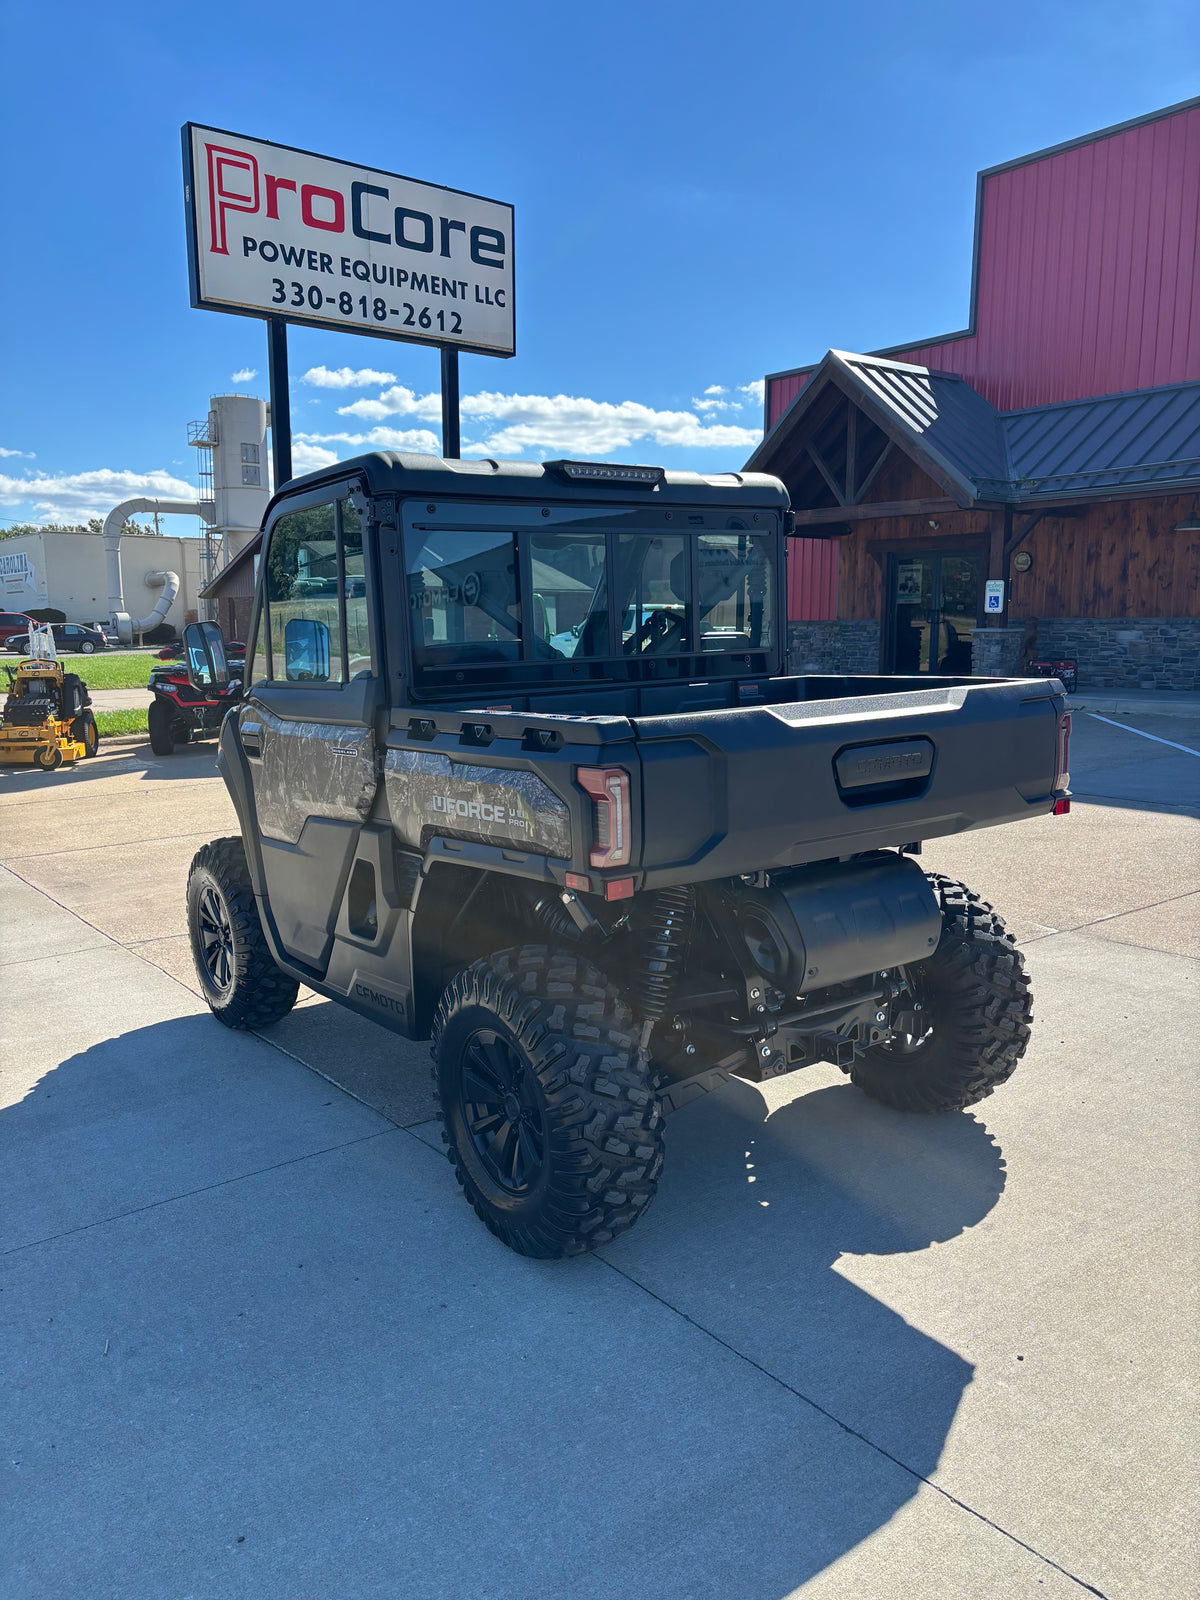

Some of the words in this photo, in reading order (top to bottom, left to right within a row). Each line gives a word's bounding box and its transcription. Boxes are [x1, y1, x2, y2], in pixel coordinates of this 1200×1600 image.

[204, 142, 505, 269] ProCore
[242, 235, 334, 275] POWER
[341, 256, 468, 300] EQUIPMENT
[475, 284, 506, 308] LLC
[271, 278, 463, 334] 330-818-2612
[432, 795, 506, 824] UFORCE
[508, 818, 525, 828] PRO
[355, 983, 405, 1015] CFMOTO
